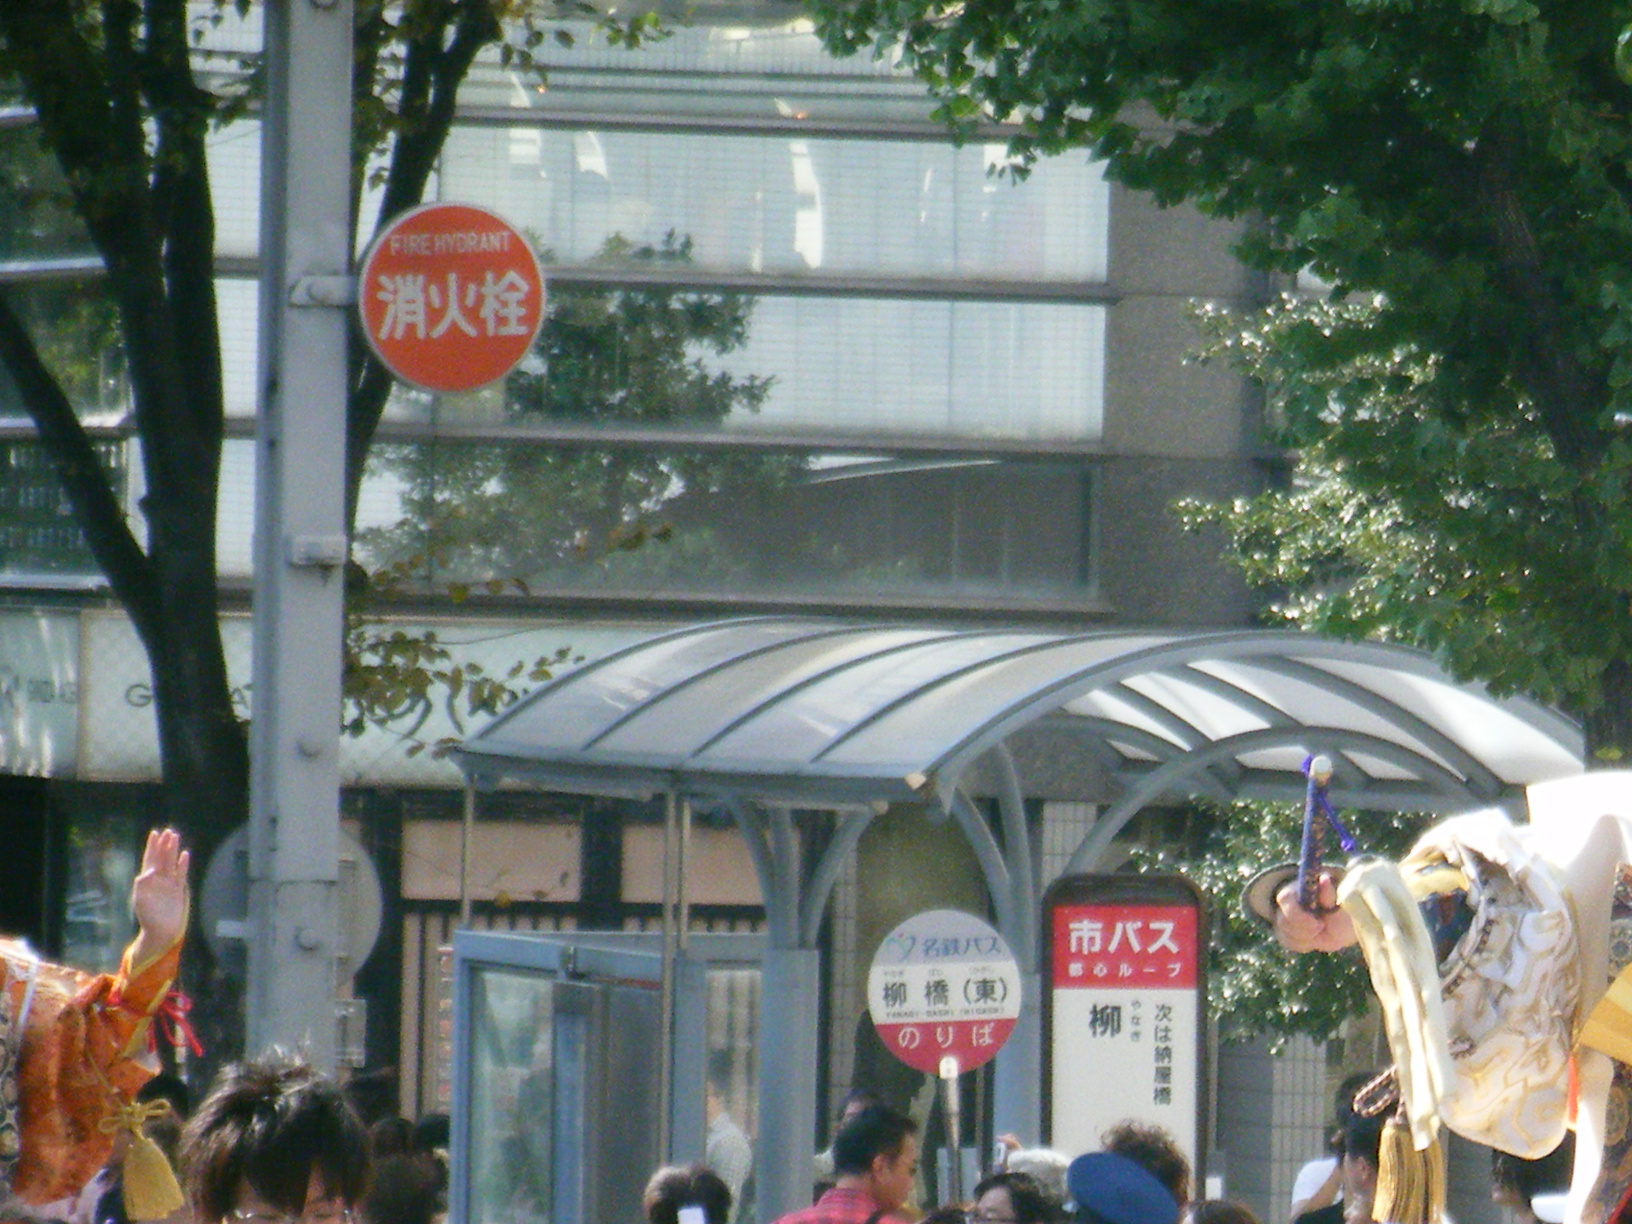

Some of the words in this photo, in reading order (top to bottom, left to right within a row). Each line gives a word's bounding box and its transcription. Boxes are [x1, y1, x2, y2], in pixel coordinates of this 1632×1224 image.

[390, 234, 431, 255] FIRE
[434, 231, 511, 254] HYDRANT
[377, 270, 529, 340] 消火栓
[922, 936, 1001, 957] 名鉄バス
[1068, 919, 1180, 955] 市バス
[1068, 962, 1182, 977] 都心ループ
[898, 1022, 994, 1049] のりば
[1089, 1003, 1122, 1039] 柳
[1153, 1003, 1173, 1106] 次は納屋橋
